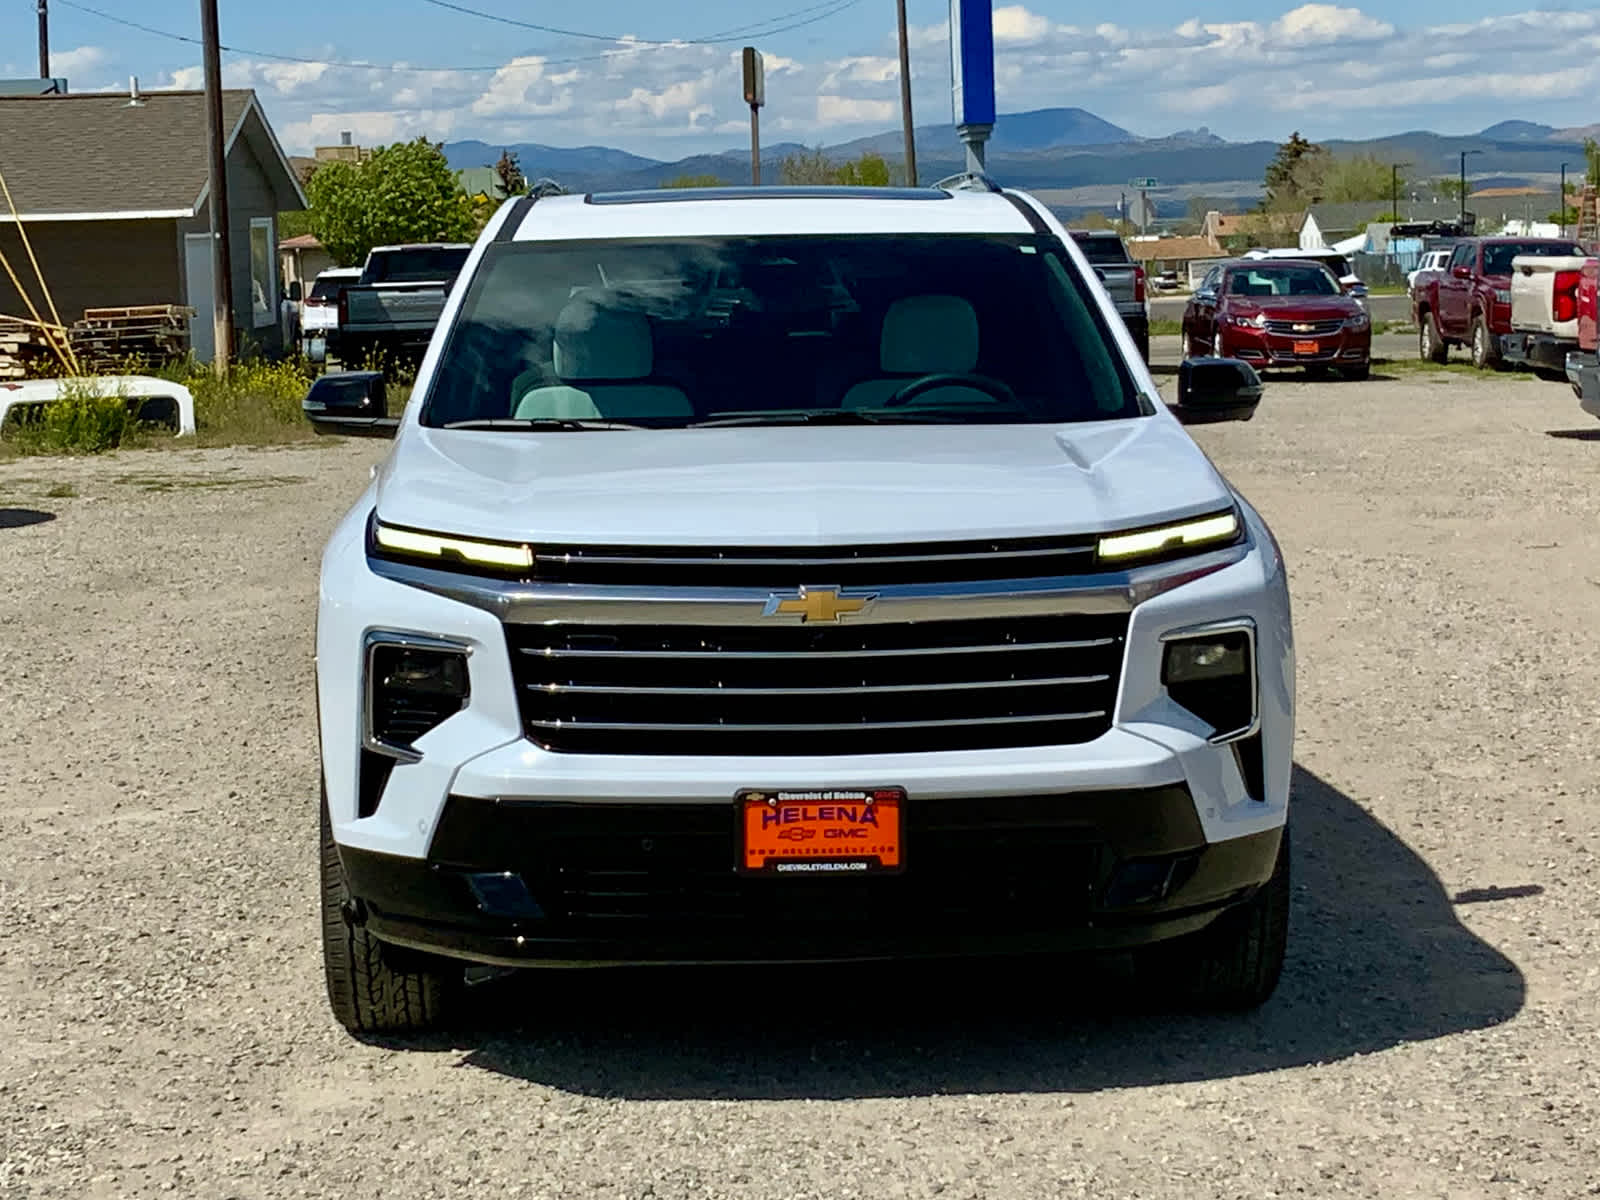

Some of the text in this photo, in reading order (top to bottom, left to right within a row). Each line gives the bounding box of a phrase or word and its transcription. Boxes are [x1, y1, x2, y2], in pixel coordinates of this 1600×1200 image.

[778, 792, 866, 801] Chevrolet of Helena
[762, 806, 878, 830] HELENA
[823, 828, 868, 838] GMC
